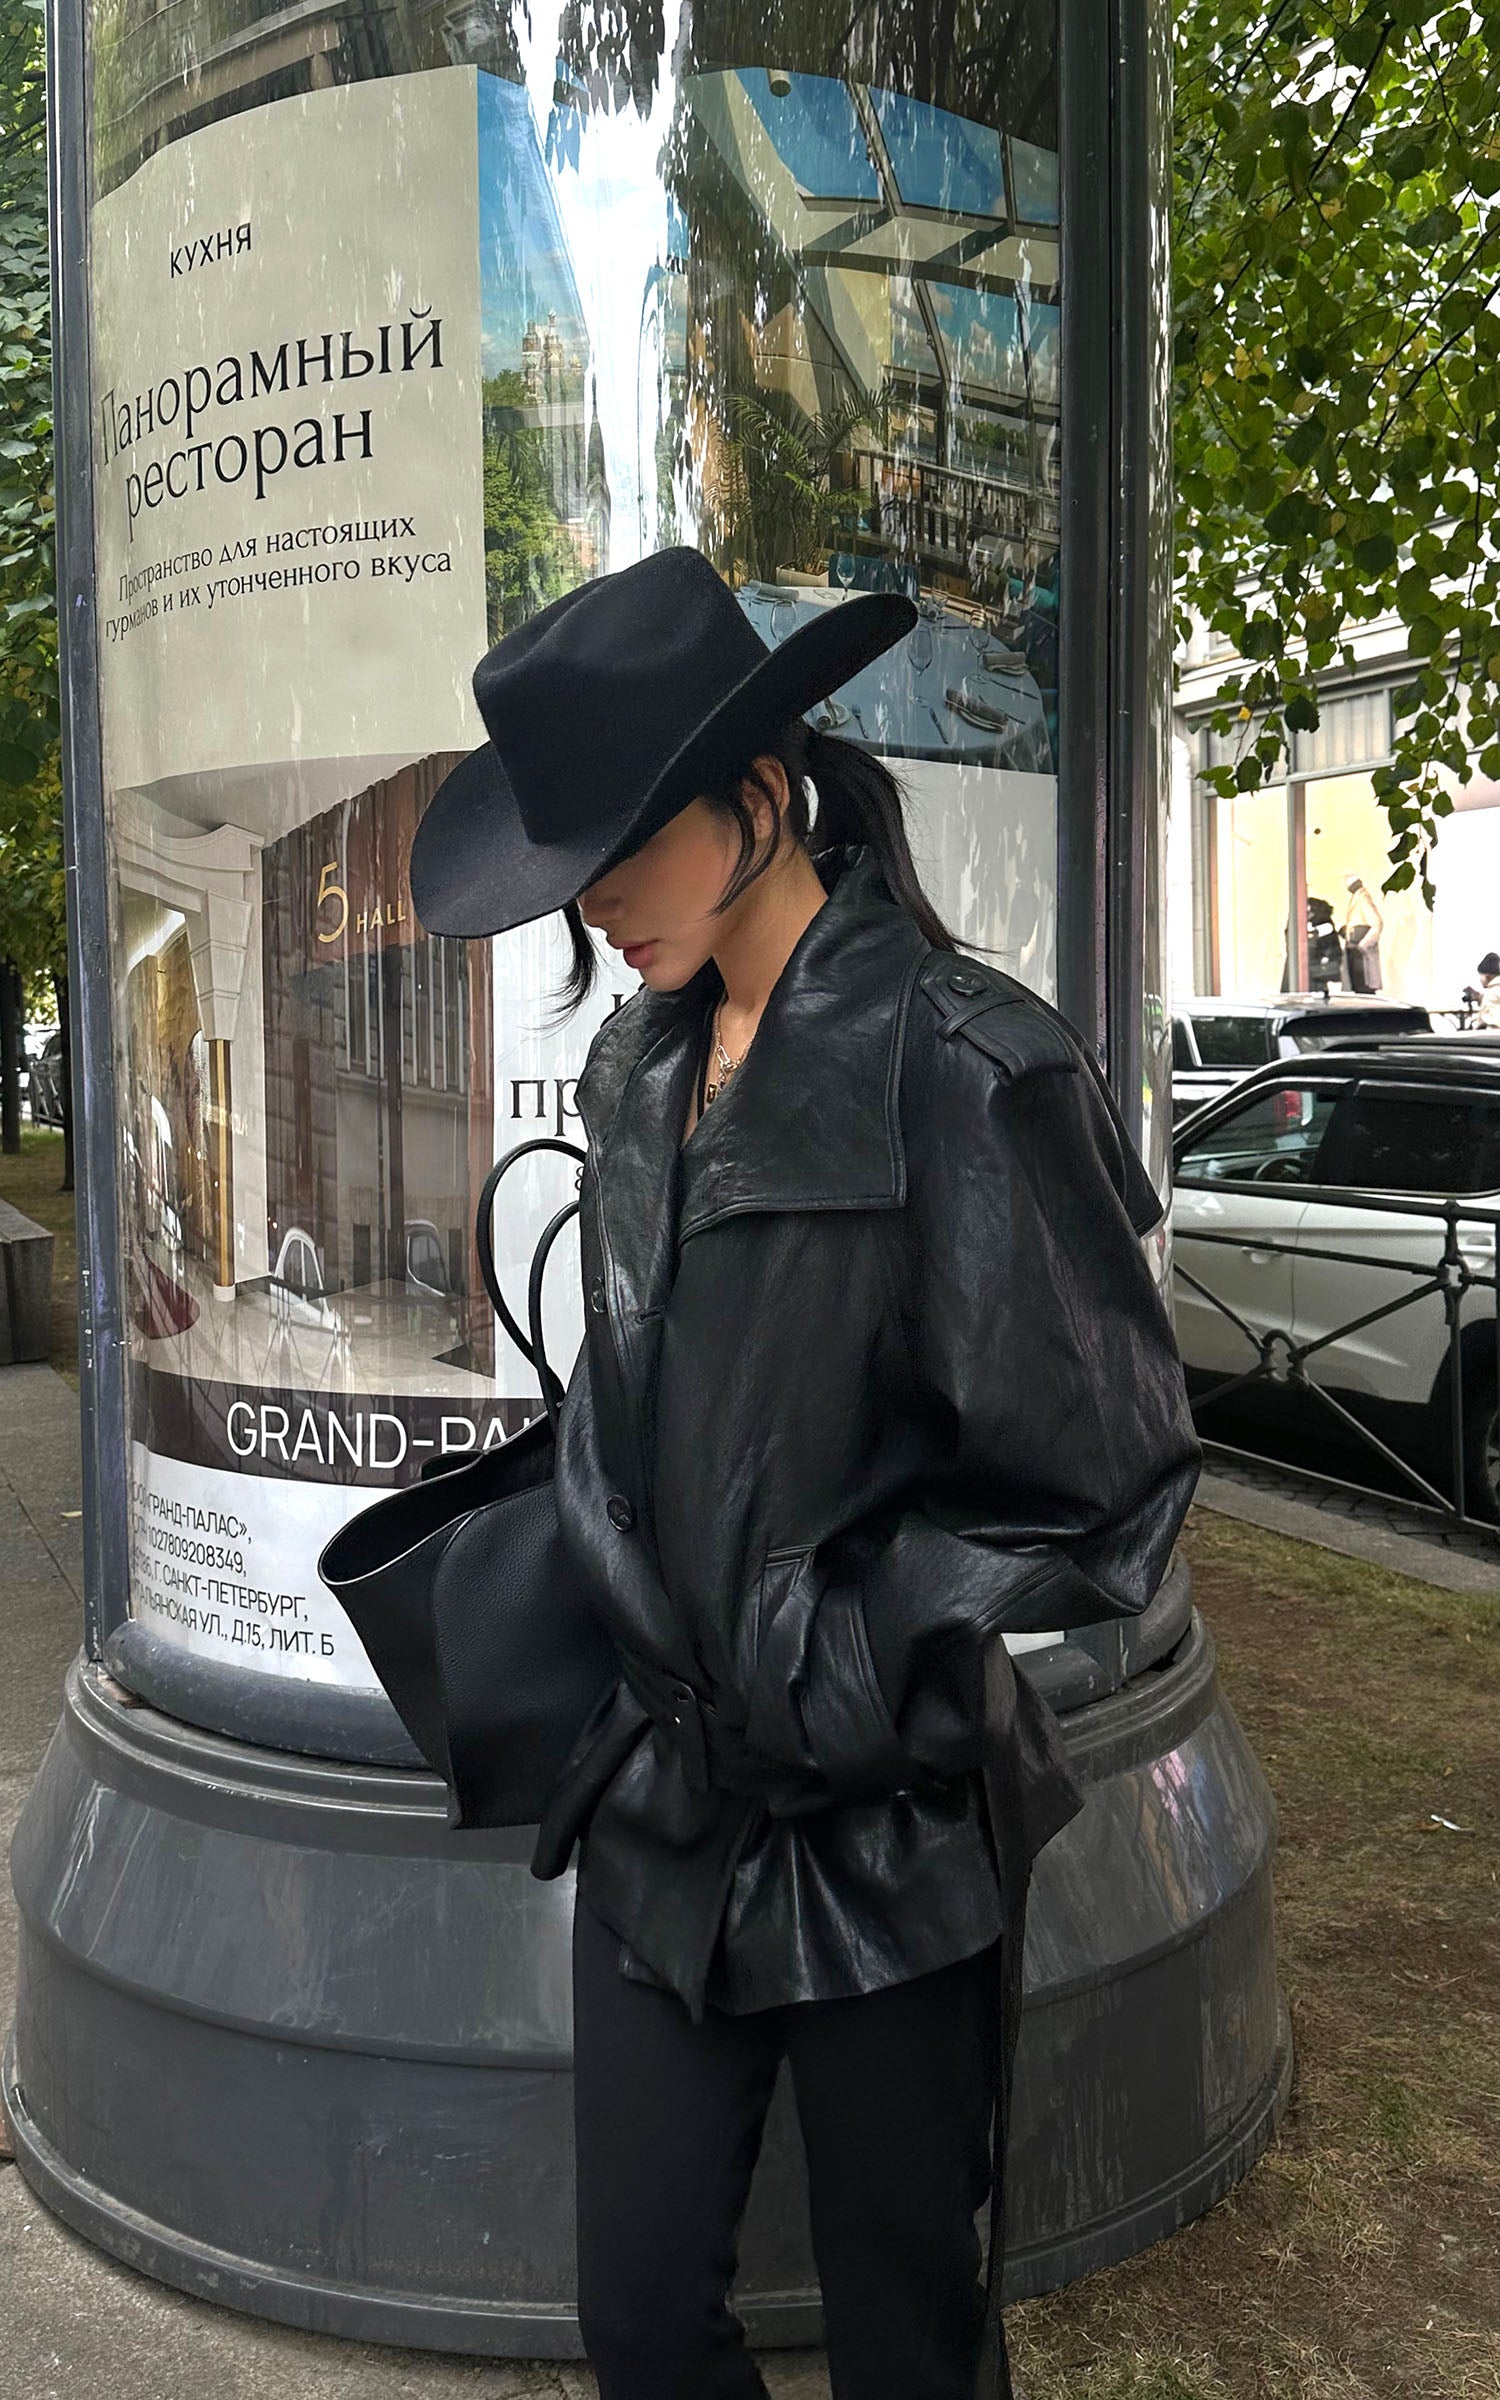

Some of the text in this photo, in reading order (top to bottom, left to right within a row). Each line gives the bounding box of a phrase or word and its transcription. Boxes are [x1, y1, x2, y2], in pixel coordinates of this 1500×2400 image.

[169, 222, 252, 278] КУХНЯ
[100, 305, 444, 466] Панорамный
[125, 409, 374, 542] ресторан
[106, 552, 452, 642] гурманов и их утонченного вкуса
[119, 515, 417, 605] Пространство для настоящих
[317, 861, 349, 943] 5
[356, 900, 406, 934] HALL
[226, 1401, 532, 1469] GRAND-PA
[163, 1564, 308, 1622] САНКТ-ПЕТЕРБУРГ,
[200, 1610, 228, 1641] УЛ.,
[232, 1619, 265, 1651] Д.15,
[269, 1628, 316, 1655] ЛИТ.
[321, 1633, 335, 1656] Б
